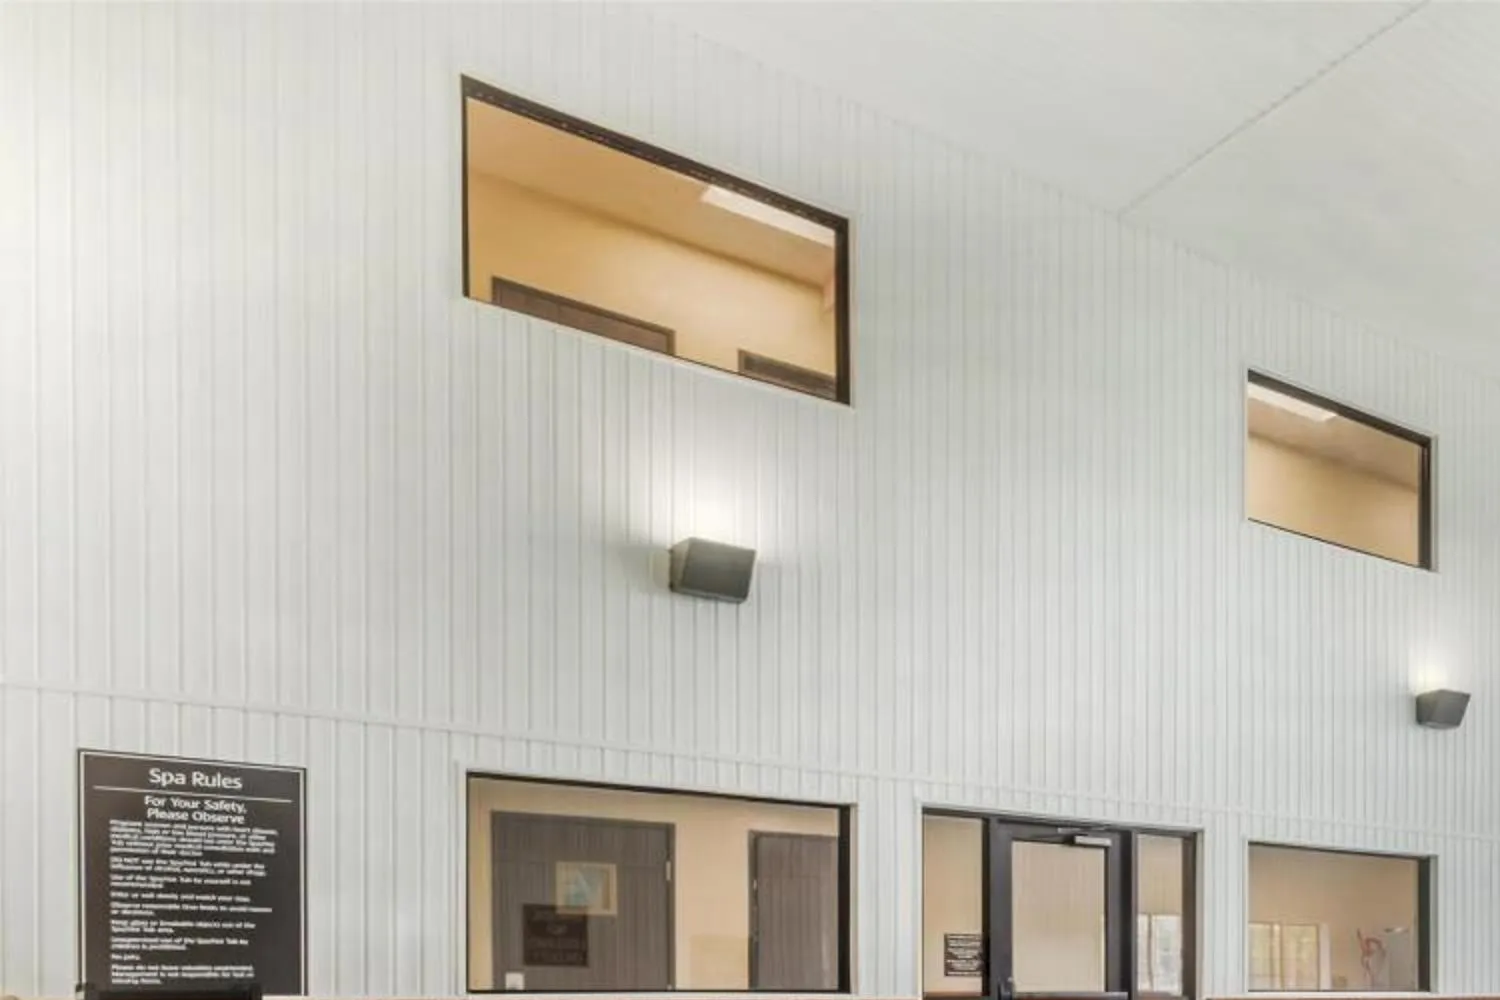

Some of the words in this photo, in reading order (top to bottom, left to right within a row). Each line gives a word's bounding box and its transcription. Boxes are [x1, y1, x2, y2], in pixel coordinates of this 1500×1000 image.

[149, 768, 186, 787] Spa
[191, 771, 243, 789] Rules
[144, 795, 165, 807] For
[170, 797, 200, 809] Your
[147, 807, 189, 820] Please
[191, 811, 245, 825] Observe
